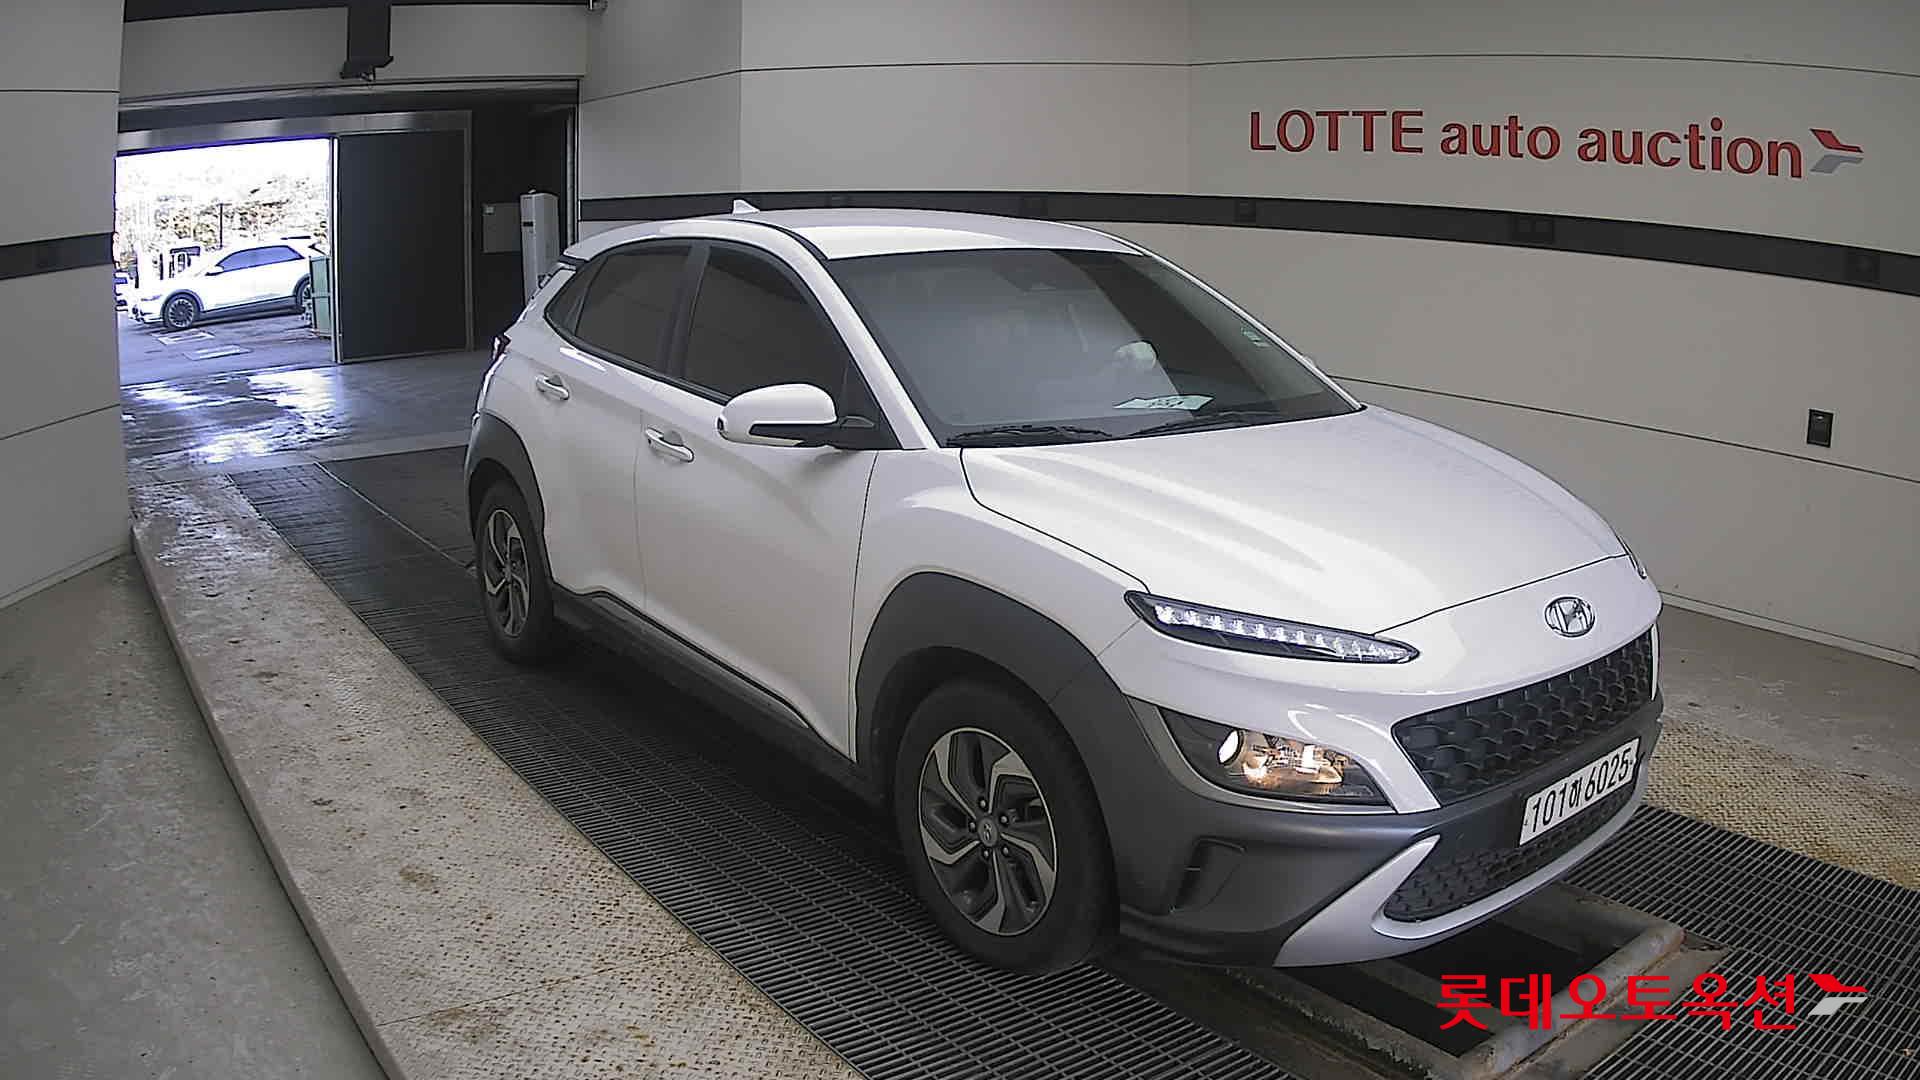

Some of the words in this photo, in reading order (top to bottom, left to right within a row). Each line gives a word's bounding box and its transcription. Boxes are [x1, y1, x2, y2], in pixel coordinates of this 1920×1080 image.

[1250, 109, 1425, 154] LOTTE
[1440, 115, 1561, 161] auto
[1577, 117, 1804, 179] auction
[1584, 747, 1632, 802] 6025
